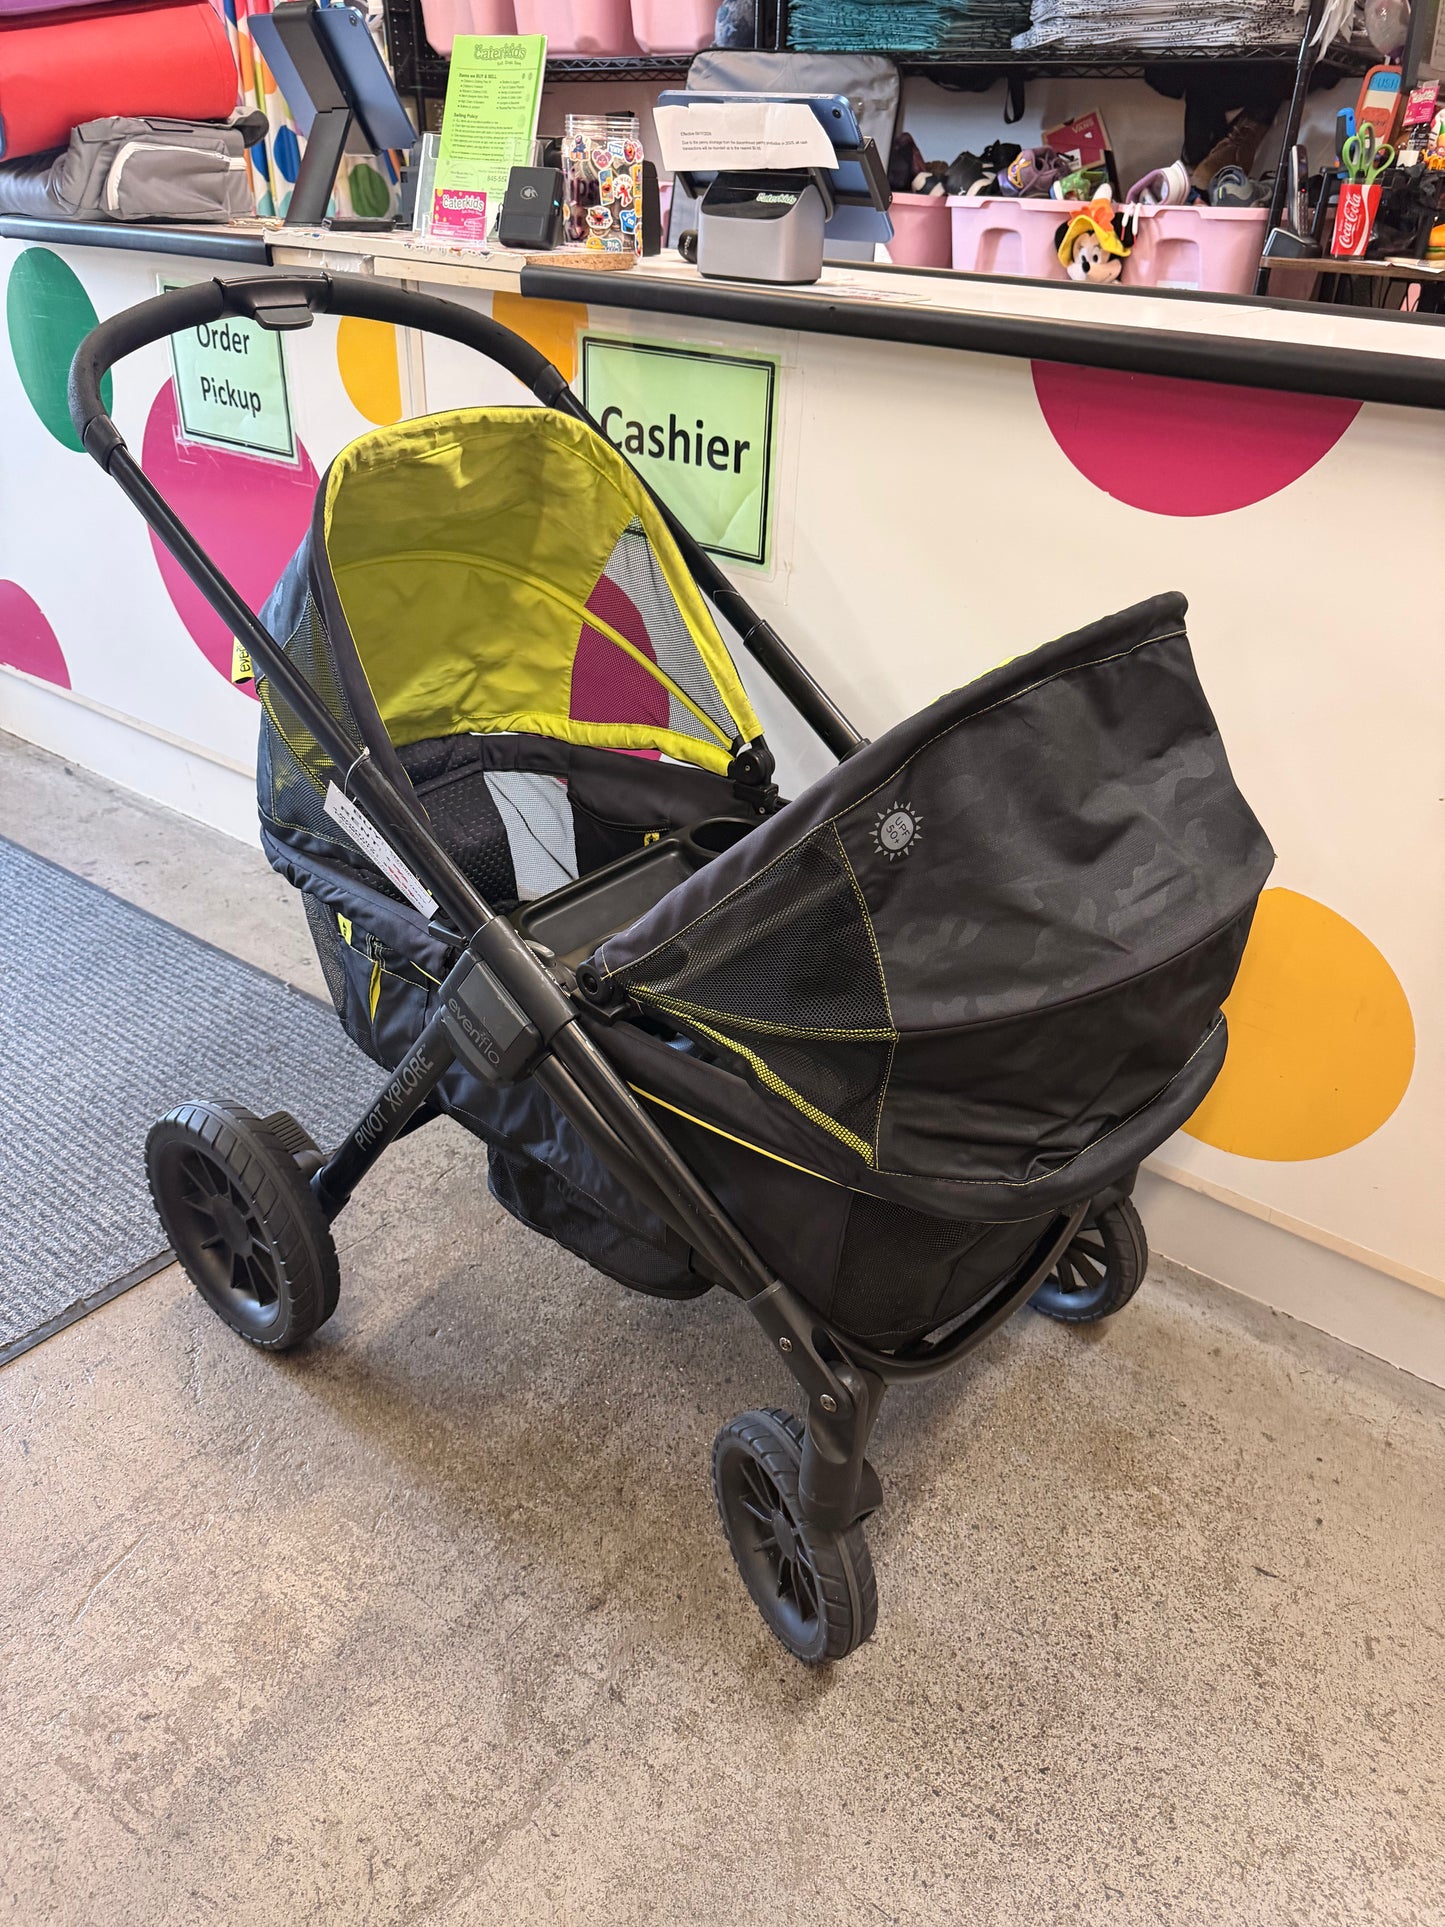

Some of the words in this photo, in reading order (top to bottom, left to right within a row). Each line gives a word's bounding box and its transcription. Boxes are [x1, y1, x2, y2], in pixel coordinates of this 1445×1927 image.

[443, 194, 485, 212] Caterkids
[1338, 192, 1361, 248] Coca-Cola
[197, 323, 250, 354] Order
[200, 376, 262, 418] Pickup
[601, 406, 751, 474] Cashier
[885, 824, 900, 844] 50+
[895, 816, 911, 837] UPF
[448, 998, 500, 1064] evenflo
[354, 1103, 389, 1152] PIVOT
[384, 1047, 434, 1112] XPLORE
